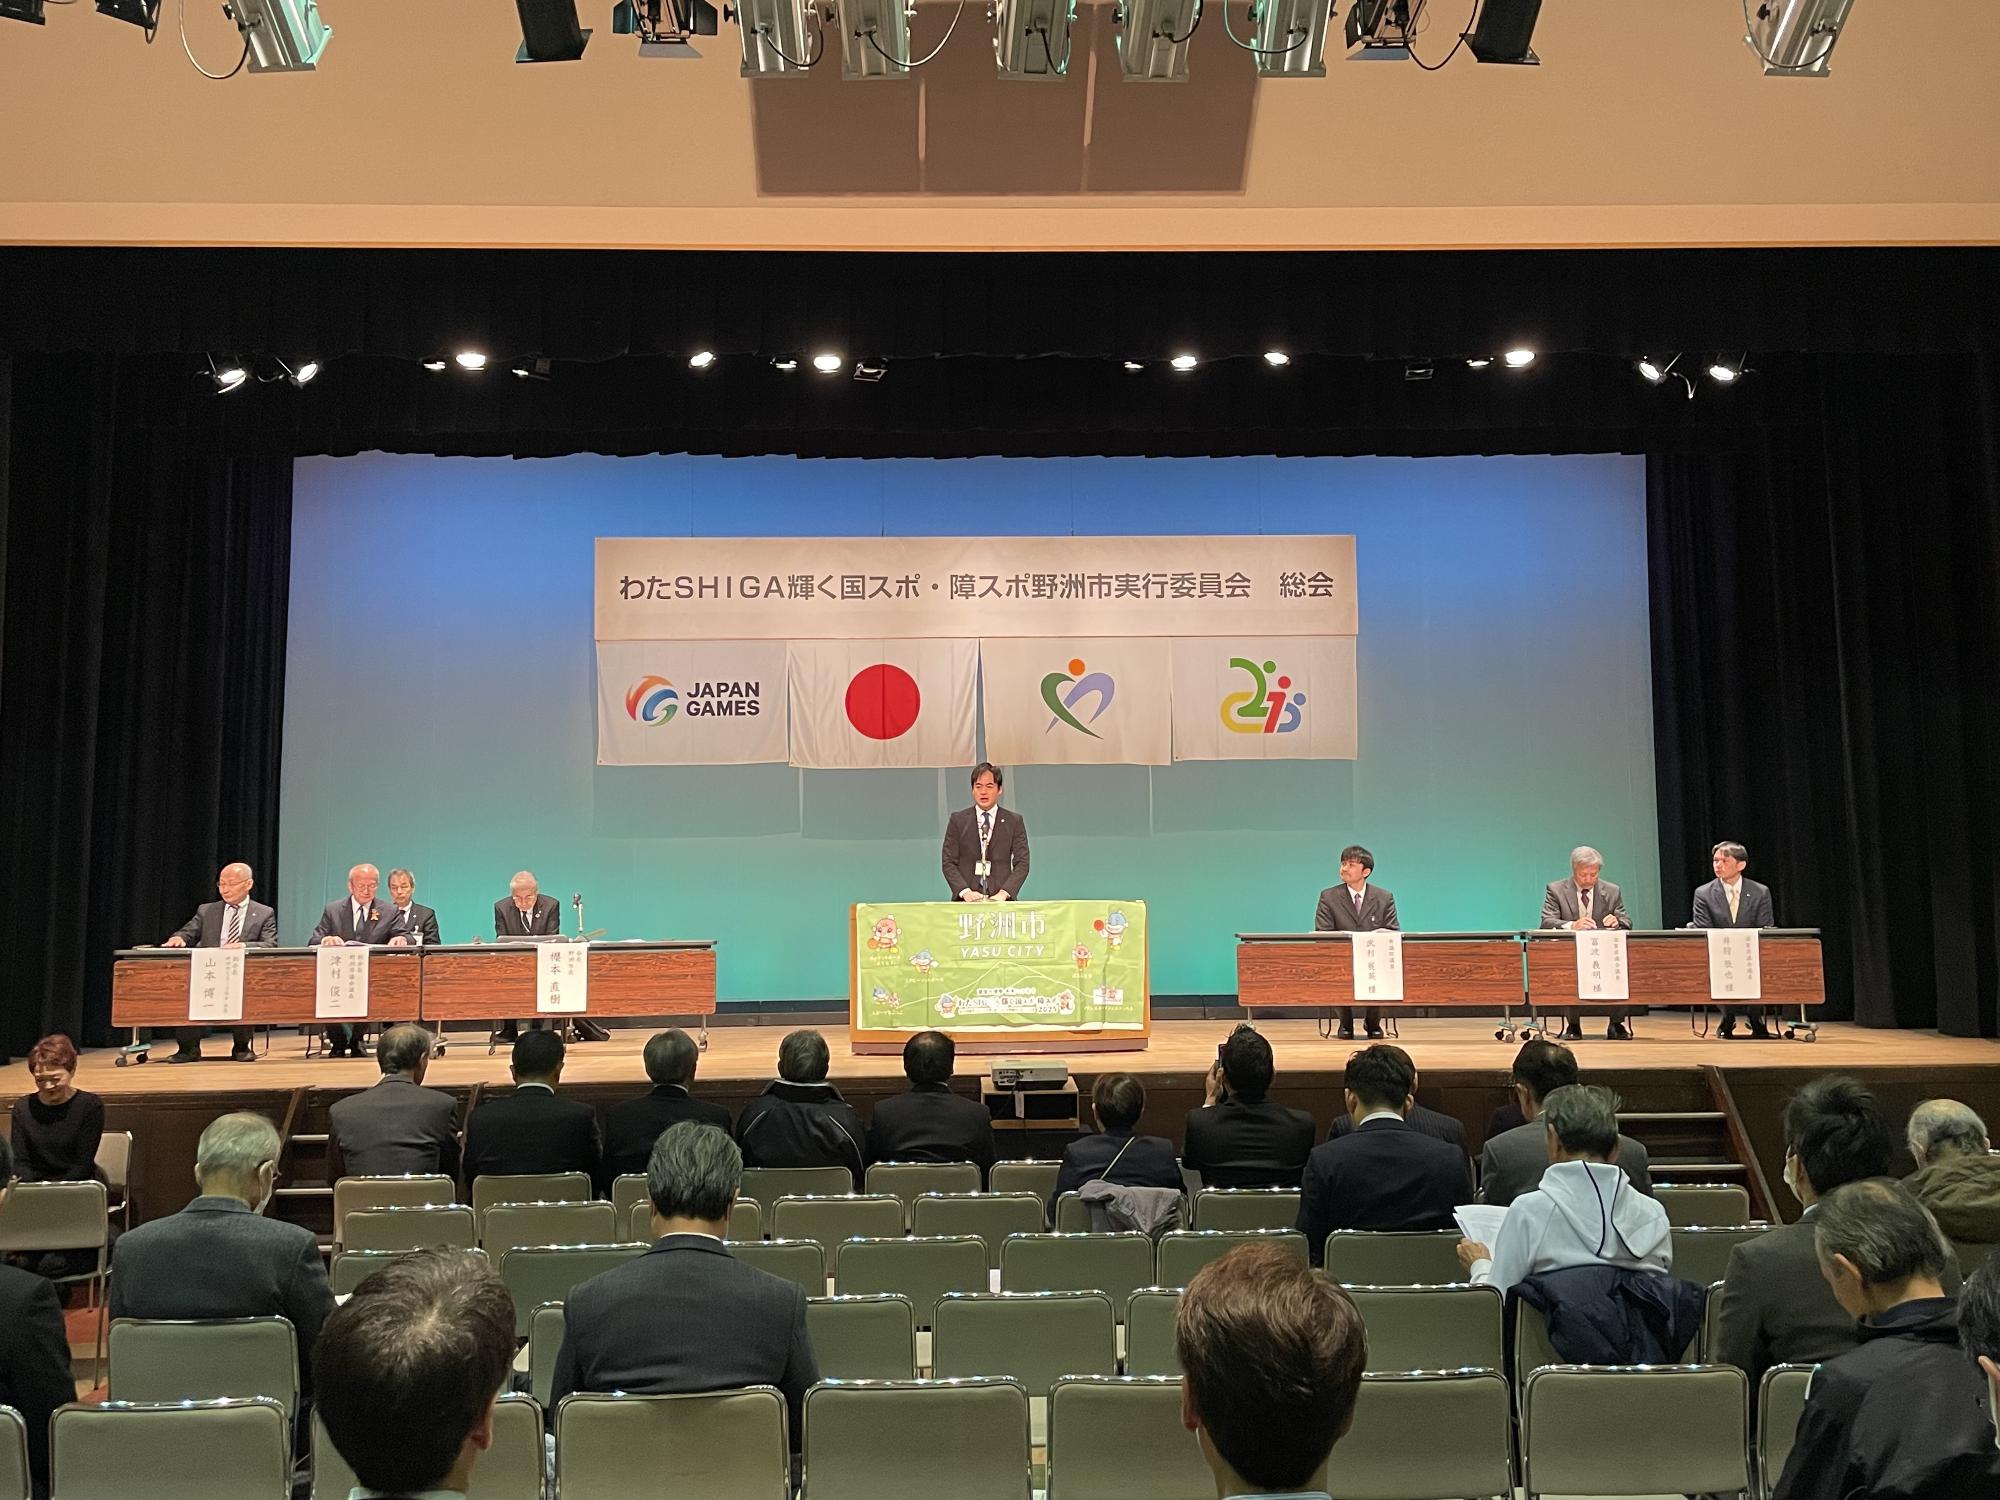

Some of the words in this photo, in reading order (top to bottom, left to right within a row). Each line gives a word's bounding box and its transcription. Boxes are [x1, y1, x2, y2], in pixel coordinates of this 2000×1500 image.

[619, 572, 1251, 601] わたSHIGA輝く国スポ・障スポ野洲市実行委員会
[1279, 571, 1334, 598] 総会
[686, 681, 760, 698] JAPAN
[685, 699, 760, 717] GAMES
[959, 910, 1045, 941] 野洲市
[960, 946, 1002, 958] YASU
[1007, 944, 1045, 957] CITY
[204, 957, 217, 981] 山本
